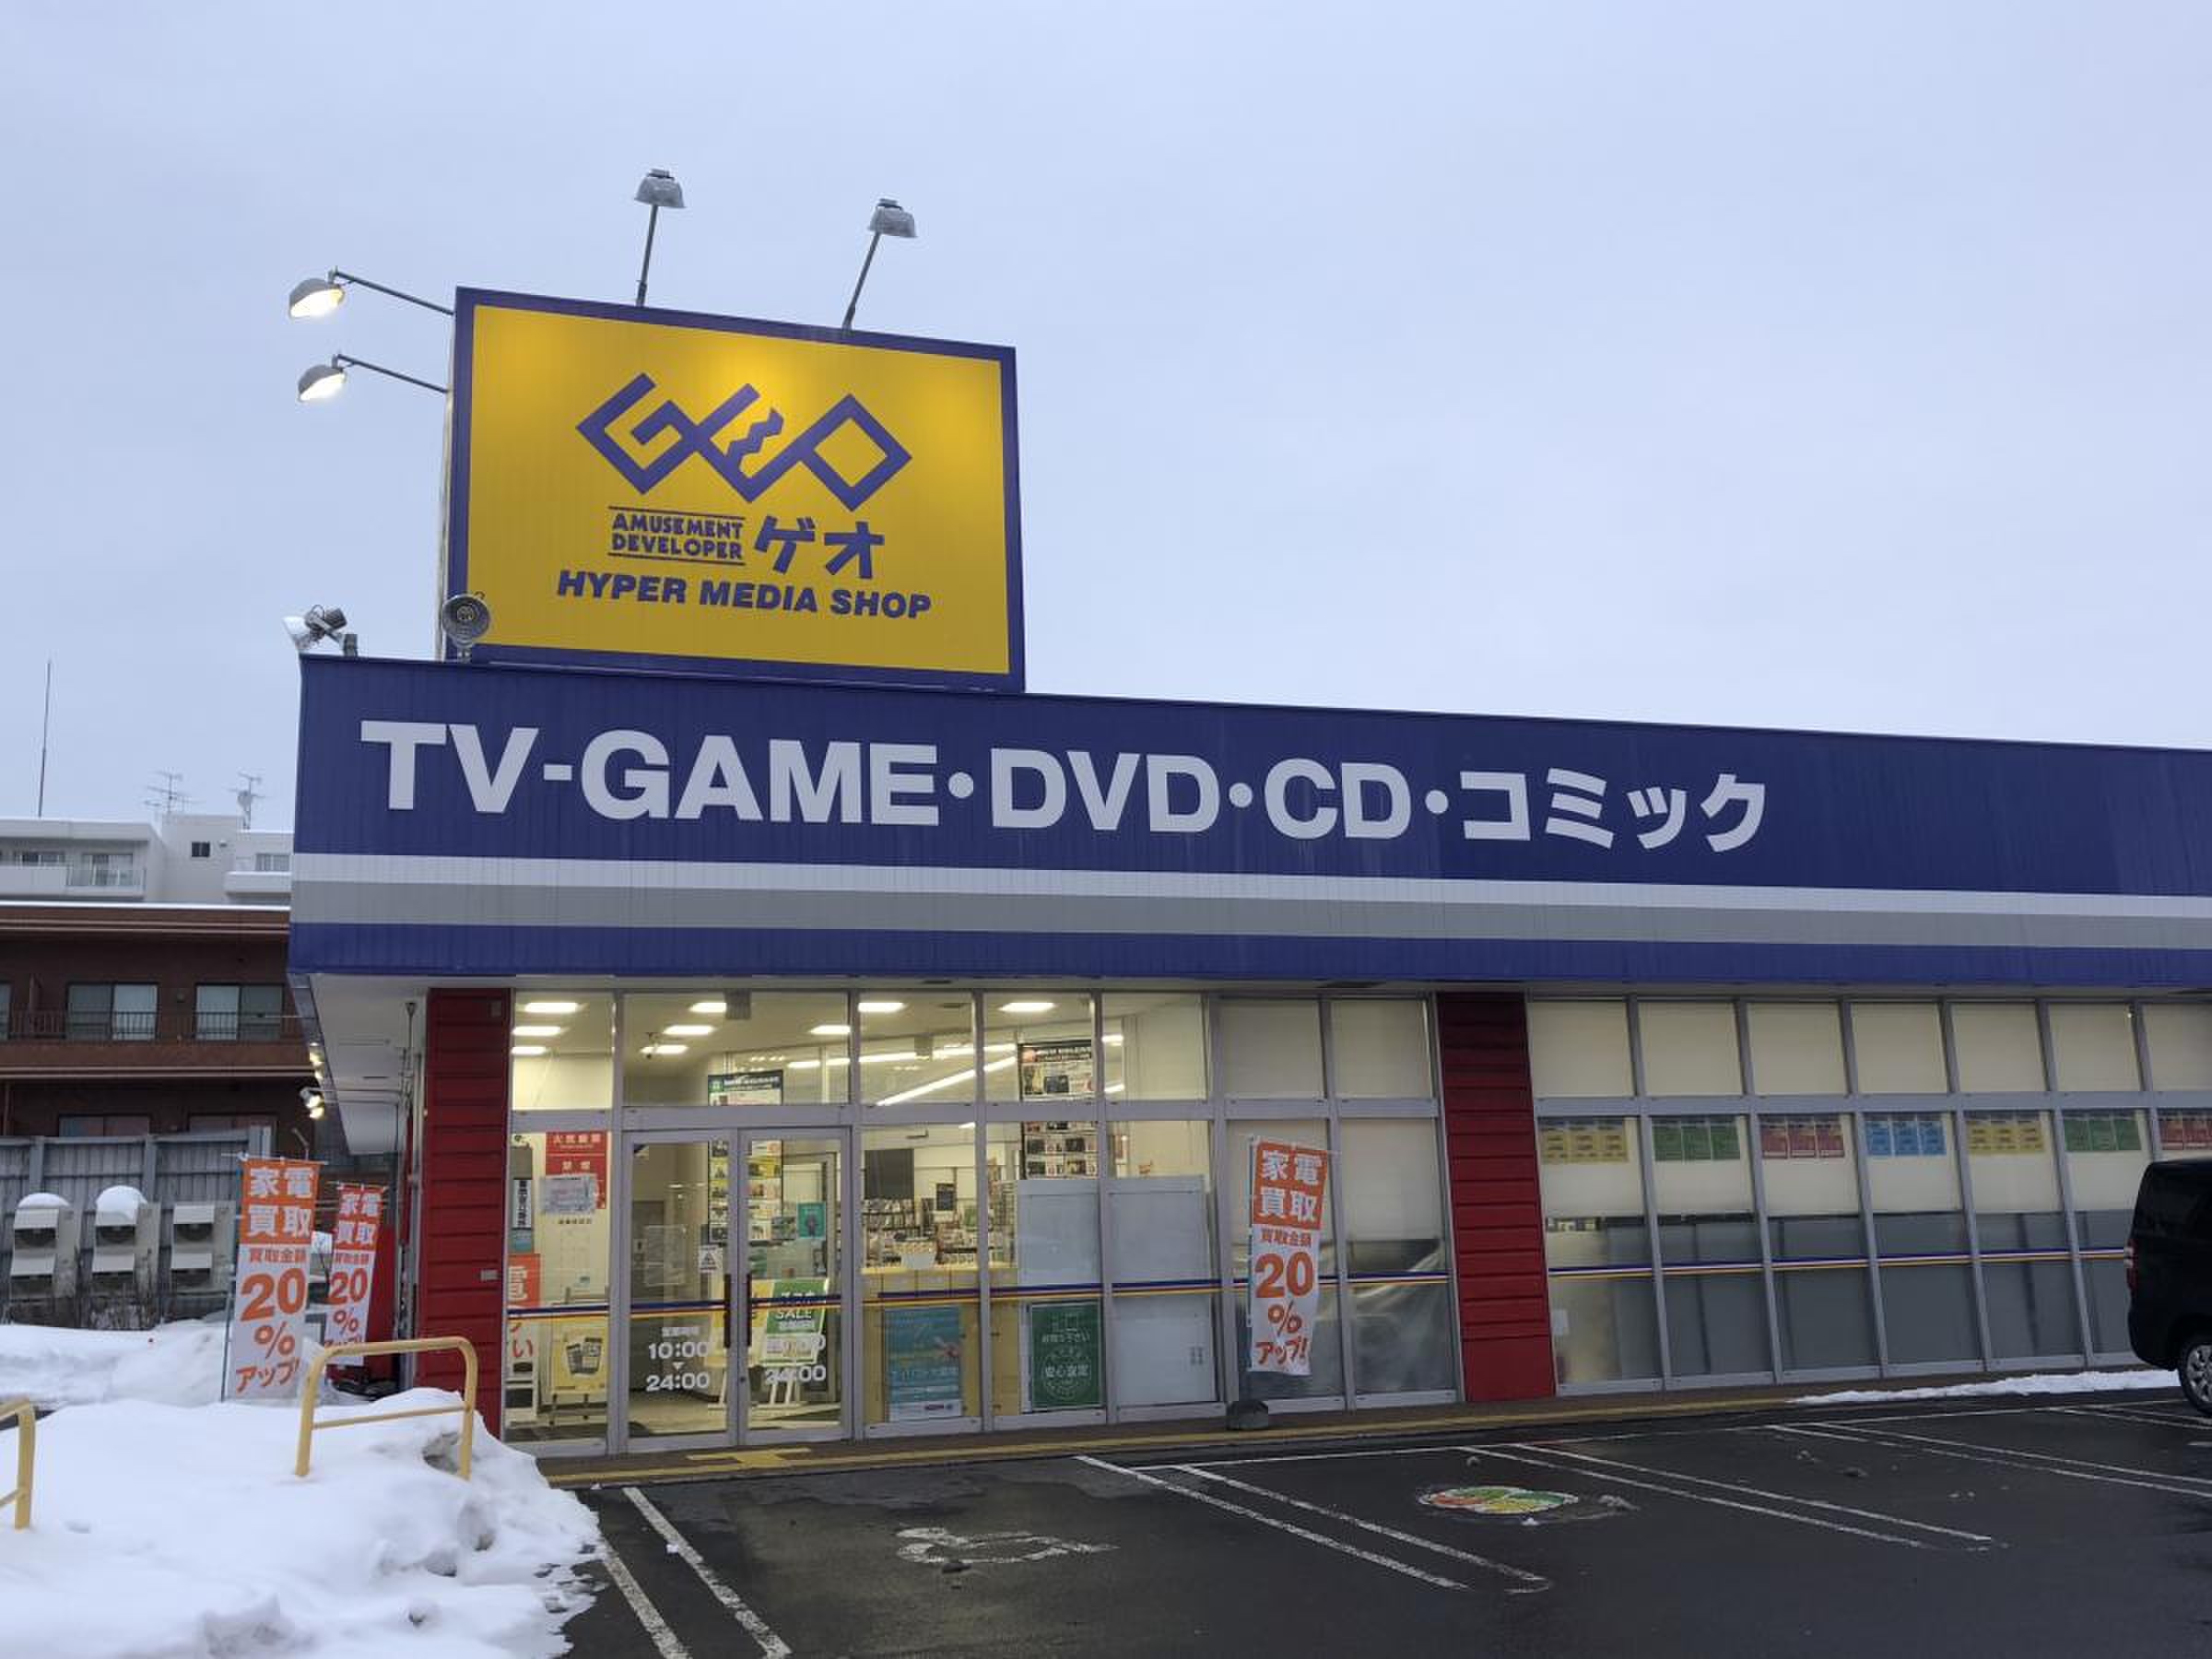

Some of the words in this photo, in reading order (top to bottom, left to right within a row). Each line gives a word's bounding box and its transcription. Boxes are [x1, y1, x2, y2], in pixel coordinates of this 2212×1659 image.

[612, 512, 744, 540] AMUSEMENT
[611, 534, 744, 560] DEVELOPER
[754, 515, 885, 580] ゲオ
[557, 569, 688, 604] HYPER
[699, 580, 818, 613] MEDIA
[830, 589, 932, 619] SHOP
[249, 1166, 314, 1199] 家電
[1261, 1149, 1323, 1186] 家電
[247, 1204, 312, 1238] 買取
[1259, 1188, 1318, 1223] 買取
[327, 1267, 368, 1306] 20
[1254, 1252, 1314, 1299] 20
[240, 1267, 307, 1322] 20
[334, 1307, 359, 1335] %
[1267, 1300, 1303, 1336] %
[253, 1321, 296, 1359] %
[648, 1341, 710, 1359] 10:00
[646, 1371, 711, 1393] 24:00
